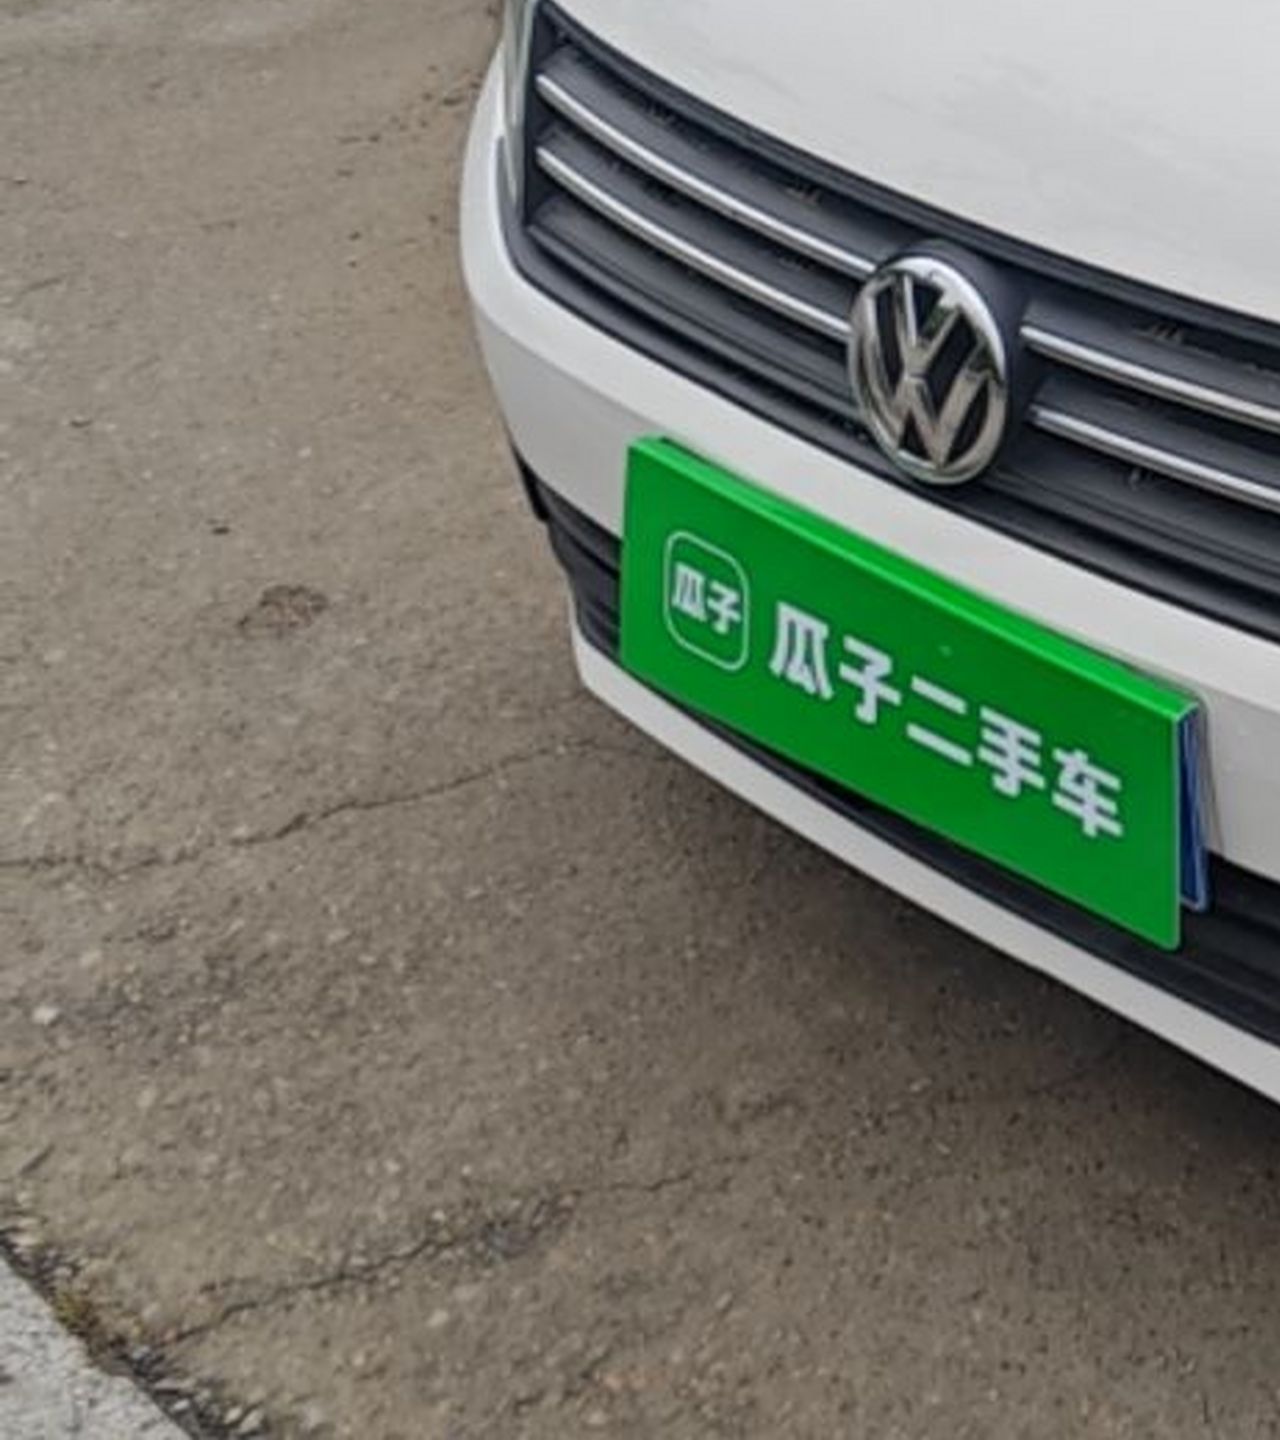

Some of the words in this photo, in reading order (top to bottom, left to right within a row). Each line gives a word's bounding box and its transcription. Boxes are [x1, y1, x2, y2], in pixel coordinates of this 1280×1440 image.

[851, 257, 1006, 483] VW
[671, 561, 741, 634] 瓜子
[769, 601, 1123, 837] 瓜子二手车
